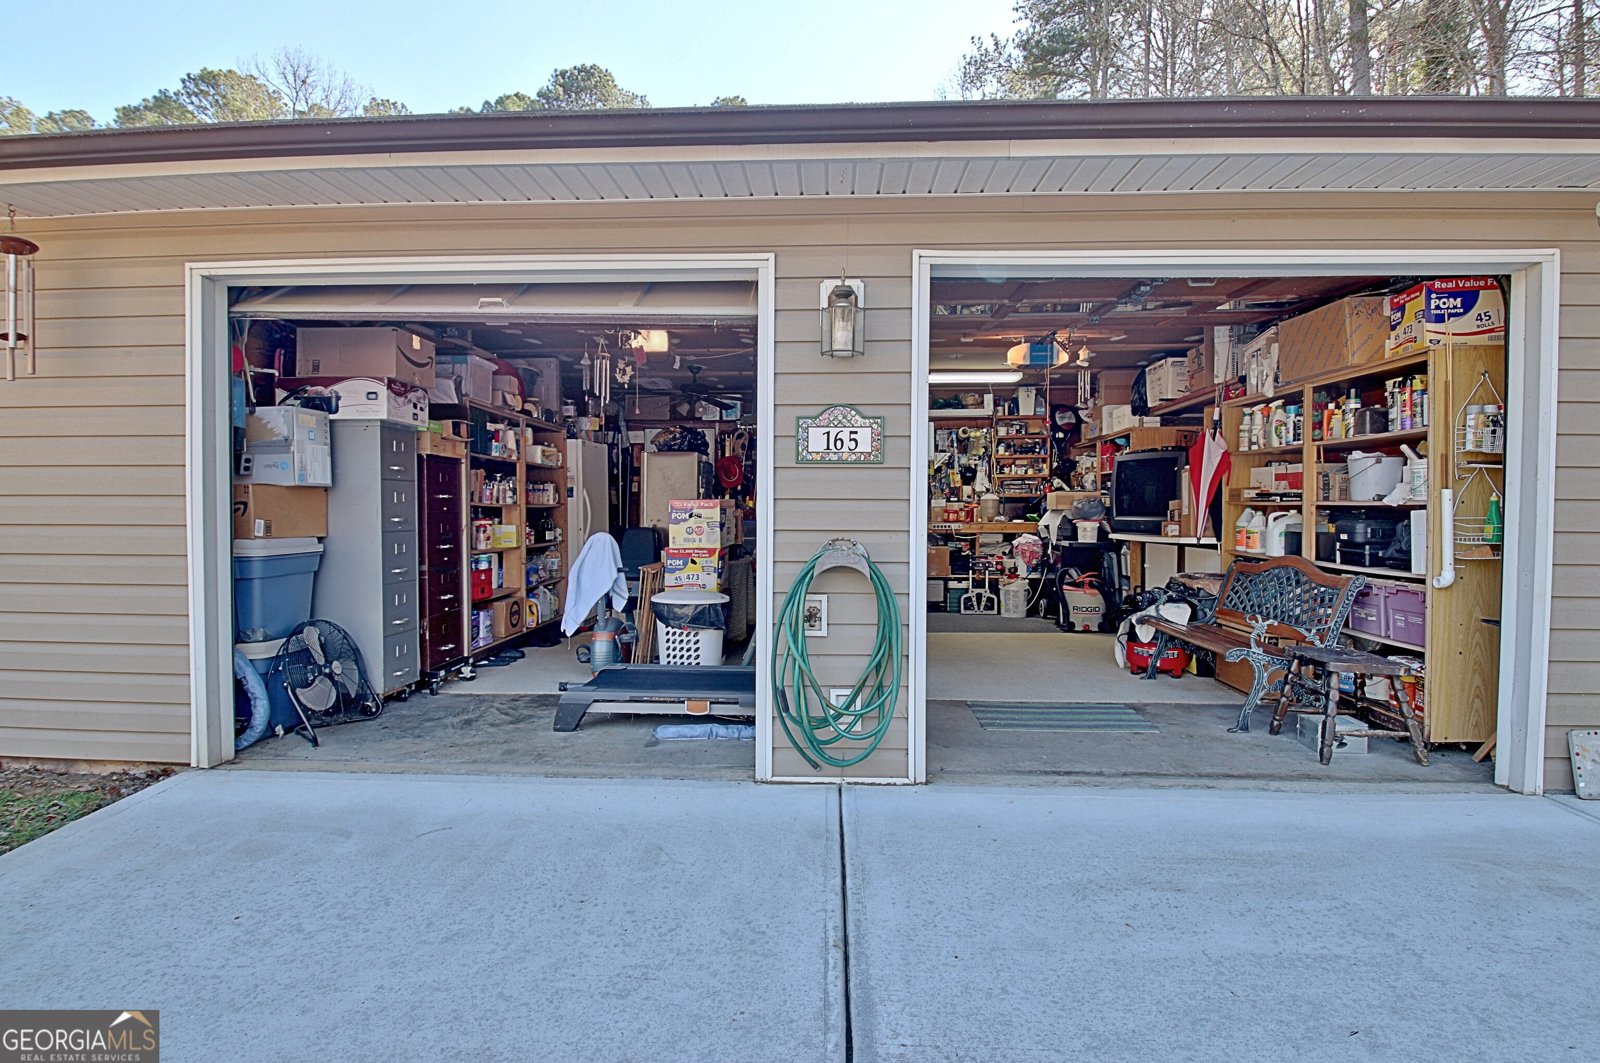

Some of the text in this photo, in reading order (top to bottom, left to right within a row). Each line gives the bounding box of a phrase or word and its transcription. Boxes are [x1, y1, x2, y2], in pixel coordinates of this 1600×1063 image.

[1434, 280, 1456, 289] Real
[1457, 279, 1485, 288] Value
[1430, 297, 1462, 310] POM
[1475, 310, 1492, 323] 45
[1402, 324, 1413, 335] 473
[1476, 321, 1495, 329] ROLLS
[822, 430, 859, 451] 165
[671, 512, 690, 520] POM
[685, 573, 700, 581] 473
[1072, 605, 1101, 613] RIDGID
